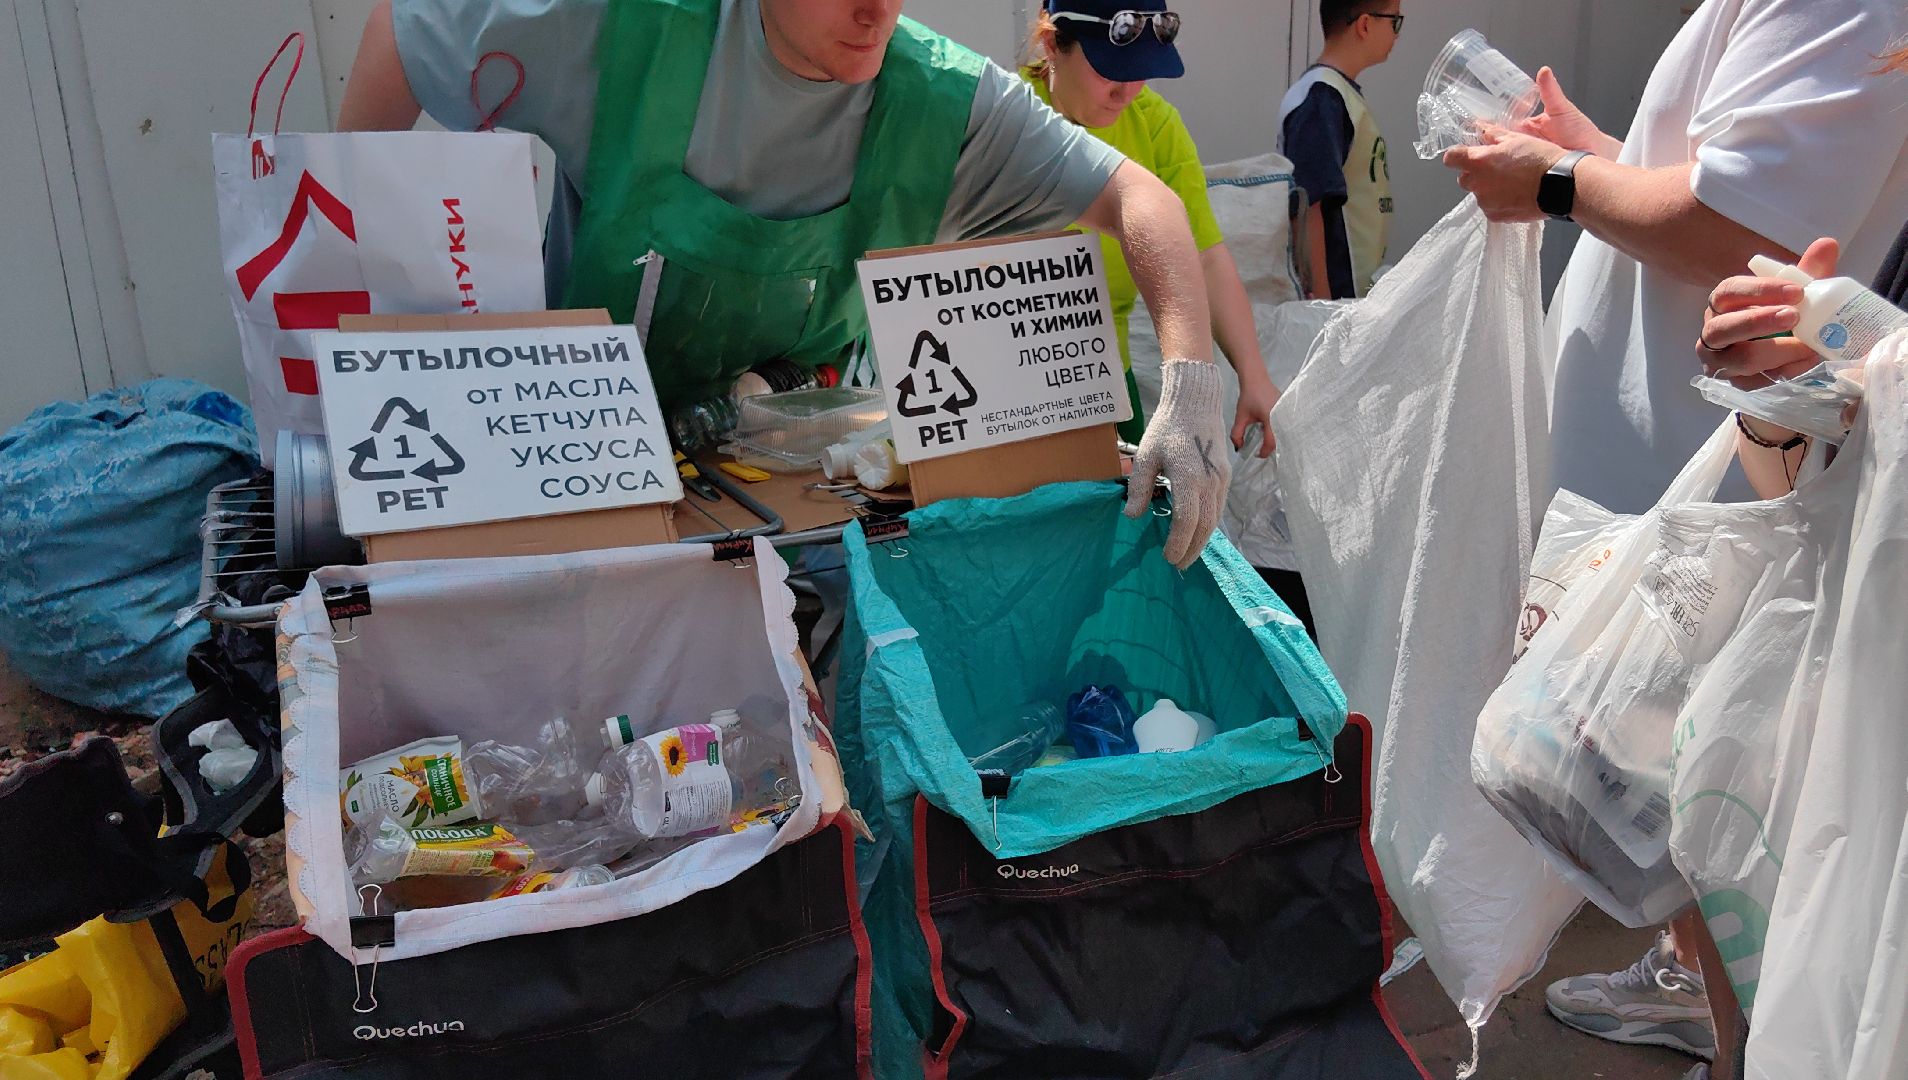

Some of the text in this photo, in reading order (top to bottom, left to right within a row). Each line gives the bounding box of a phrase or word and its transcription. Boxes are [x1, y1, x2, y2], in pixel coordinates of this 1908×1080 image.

[442, 198, 479, 314] НУКИ
[872, 246, 1095, 304] БУТЫЛОЧНЫЙ
[971, 287, 1099, 322] КОСМЕТИКИ
[1011, 309, 1103, 339] И ХИМИИ
[333, 336, 631, 374] БУТЫЛОЧНЫЙ
[1018, 337, 1105, 367] ЛЮБОГО
[514, 376, 640, 402] МАСЛА
[925, 369, 943, 394] 1
[1045, 361, 1111, 389] ЦВЕТА
[486, 406, 648, 437] КЕТЧУПА
[981, 390, 1113, 423] НЕСТАНДАРТНЫЕ ЦВЕТА
[986, 402, 1116, 436] БУТЫЛОК ОТ НАПИТКОВ
[394, 435, 417, 460] 1
[511, 437, 657, 468] УКСУСА
[539, 469, 665, 500] СОУСА
[386, 779, 400, 813] МАСЛО
[436, 758, 457, 808] СТАНИЧНОЕ
[997, 863, 1080, 879] Quechua
[353, 1020, 465, 1041] Quechua
